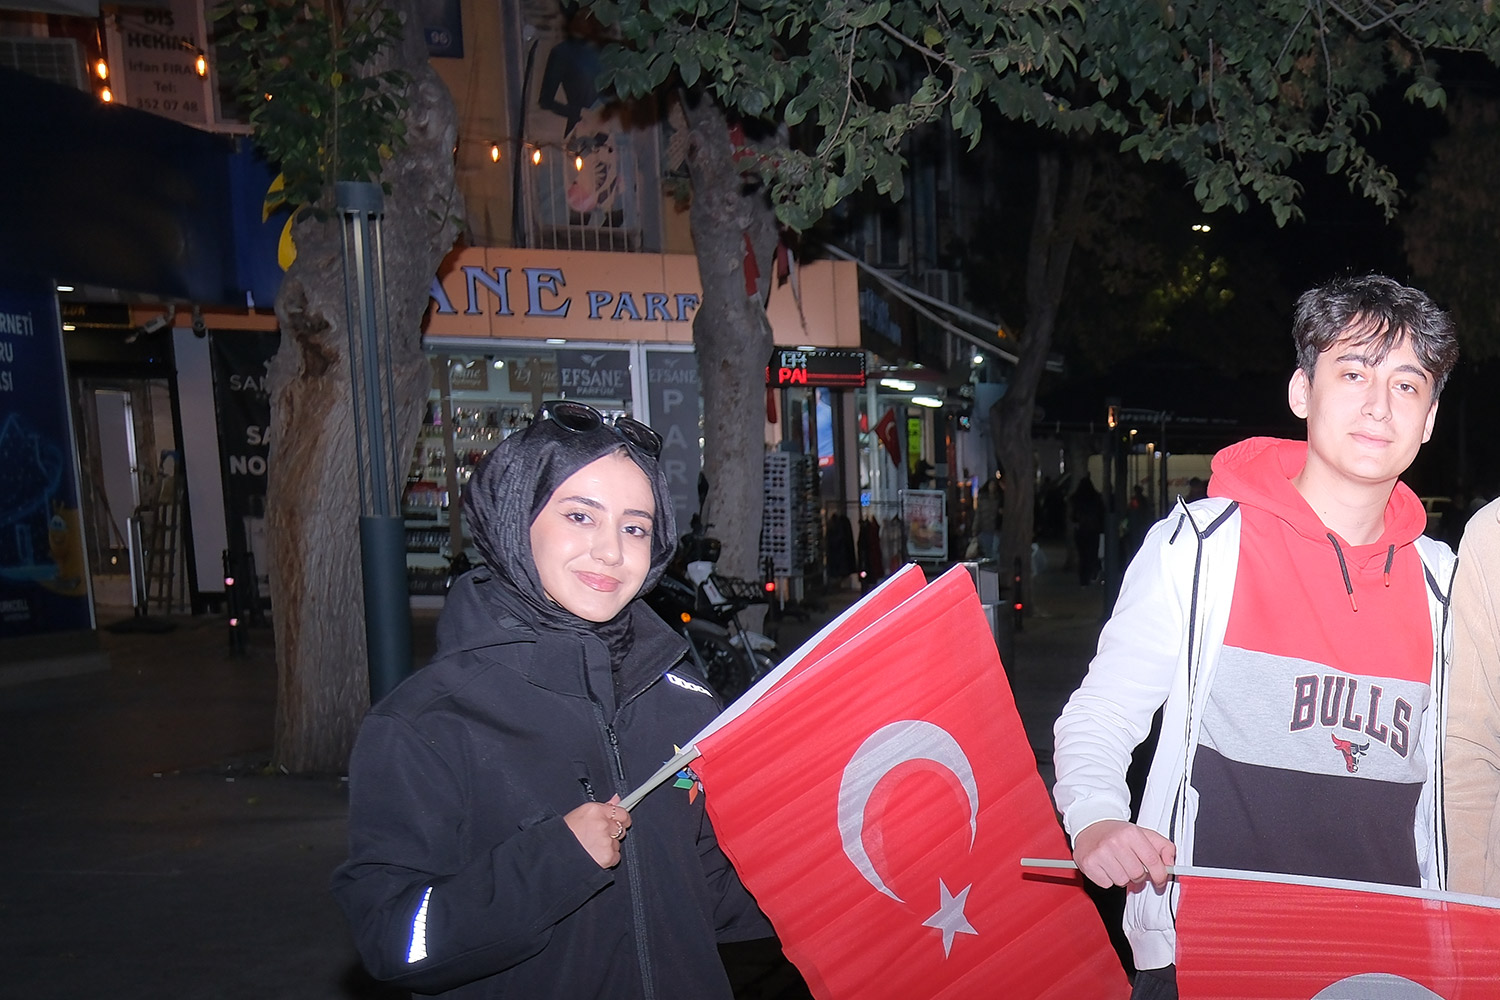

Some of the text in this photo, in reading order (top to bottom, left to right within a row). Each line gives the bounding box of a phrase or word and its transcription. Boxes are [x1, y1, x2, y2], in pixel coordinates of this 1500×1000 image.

[163, 63, 197, 76] FIRA
[561, 368, 624, 388] EFSANE
[650, 367, 698, 386] EFSANE
[1289, 674, 1413, 760] BULLS
